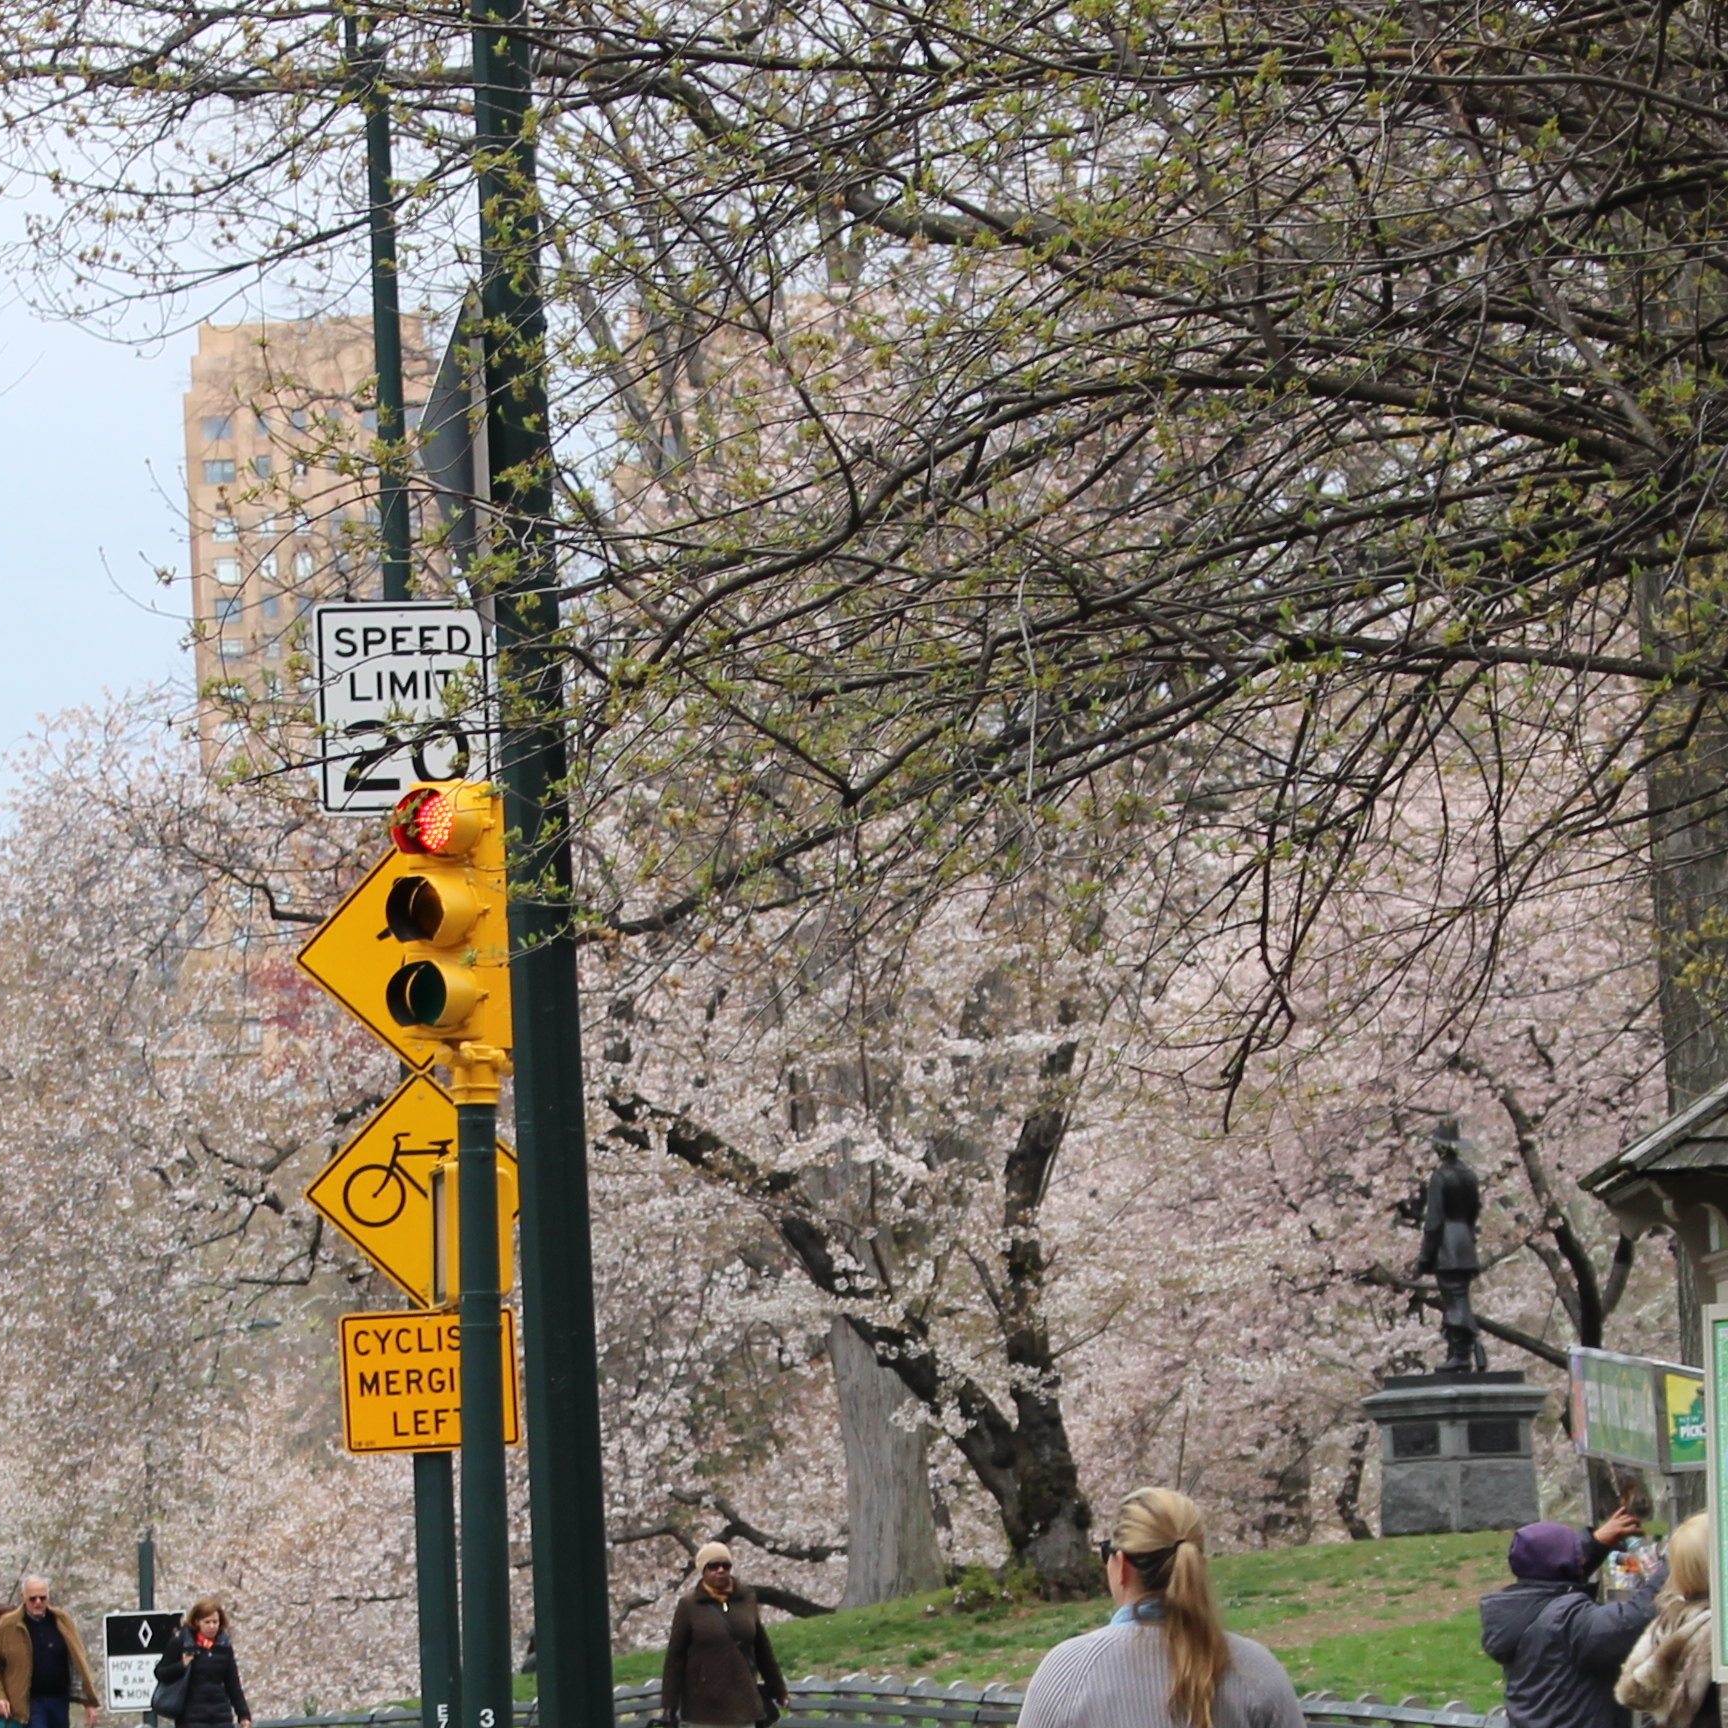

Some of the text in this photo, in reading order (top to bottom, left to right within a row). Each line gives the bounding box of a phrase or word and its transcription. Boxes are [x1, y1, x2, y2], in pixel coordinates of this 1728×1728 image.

[335, 625, 471, 657] SPEED
[350, 670, 456, 701] LIMIT
[344, 717, 471, 792] 20
[354, 1325, 460, 1356] CYCLIS
[359, 1367, 455, 1397] MERGI
[112, 1659, 133, 1671] HOV
[122, 1675, 129, 1685] 8
[132, 1675, 145, 1684] AM
[127, 1688, 150, 1699] MON
